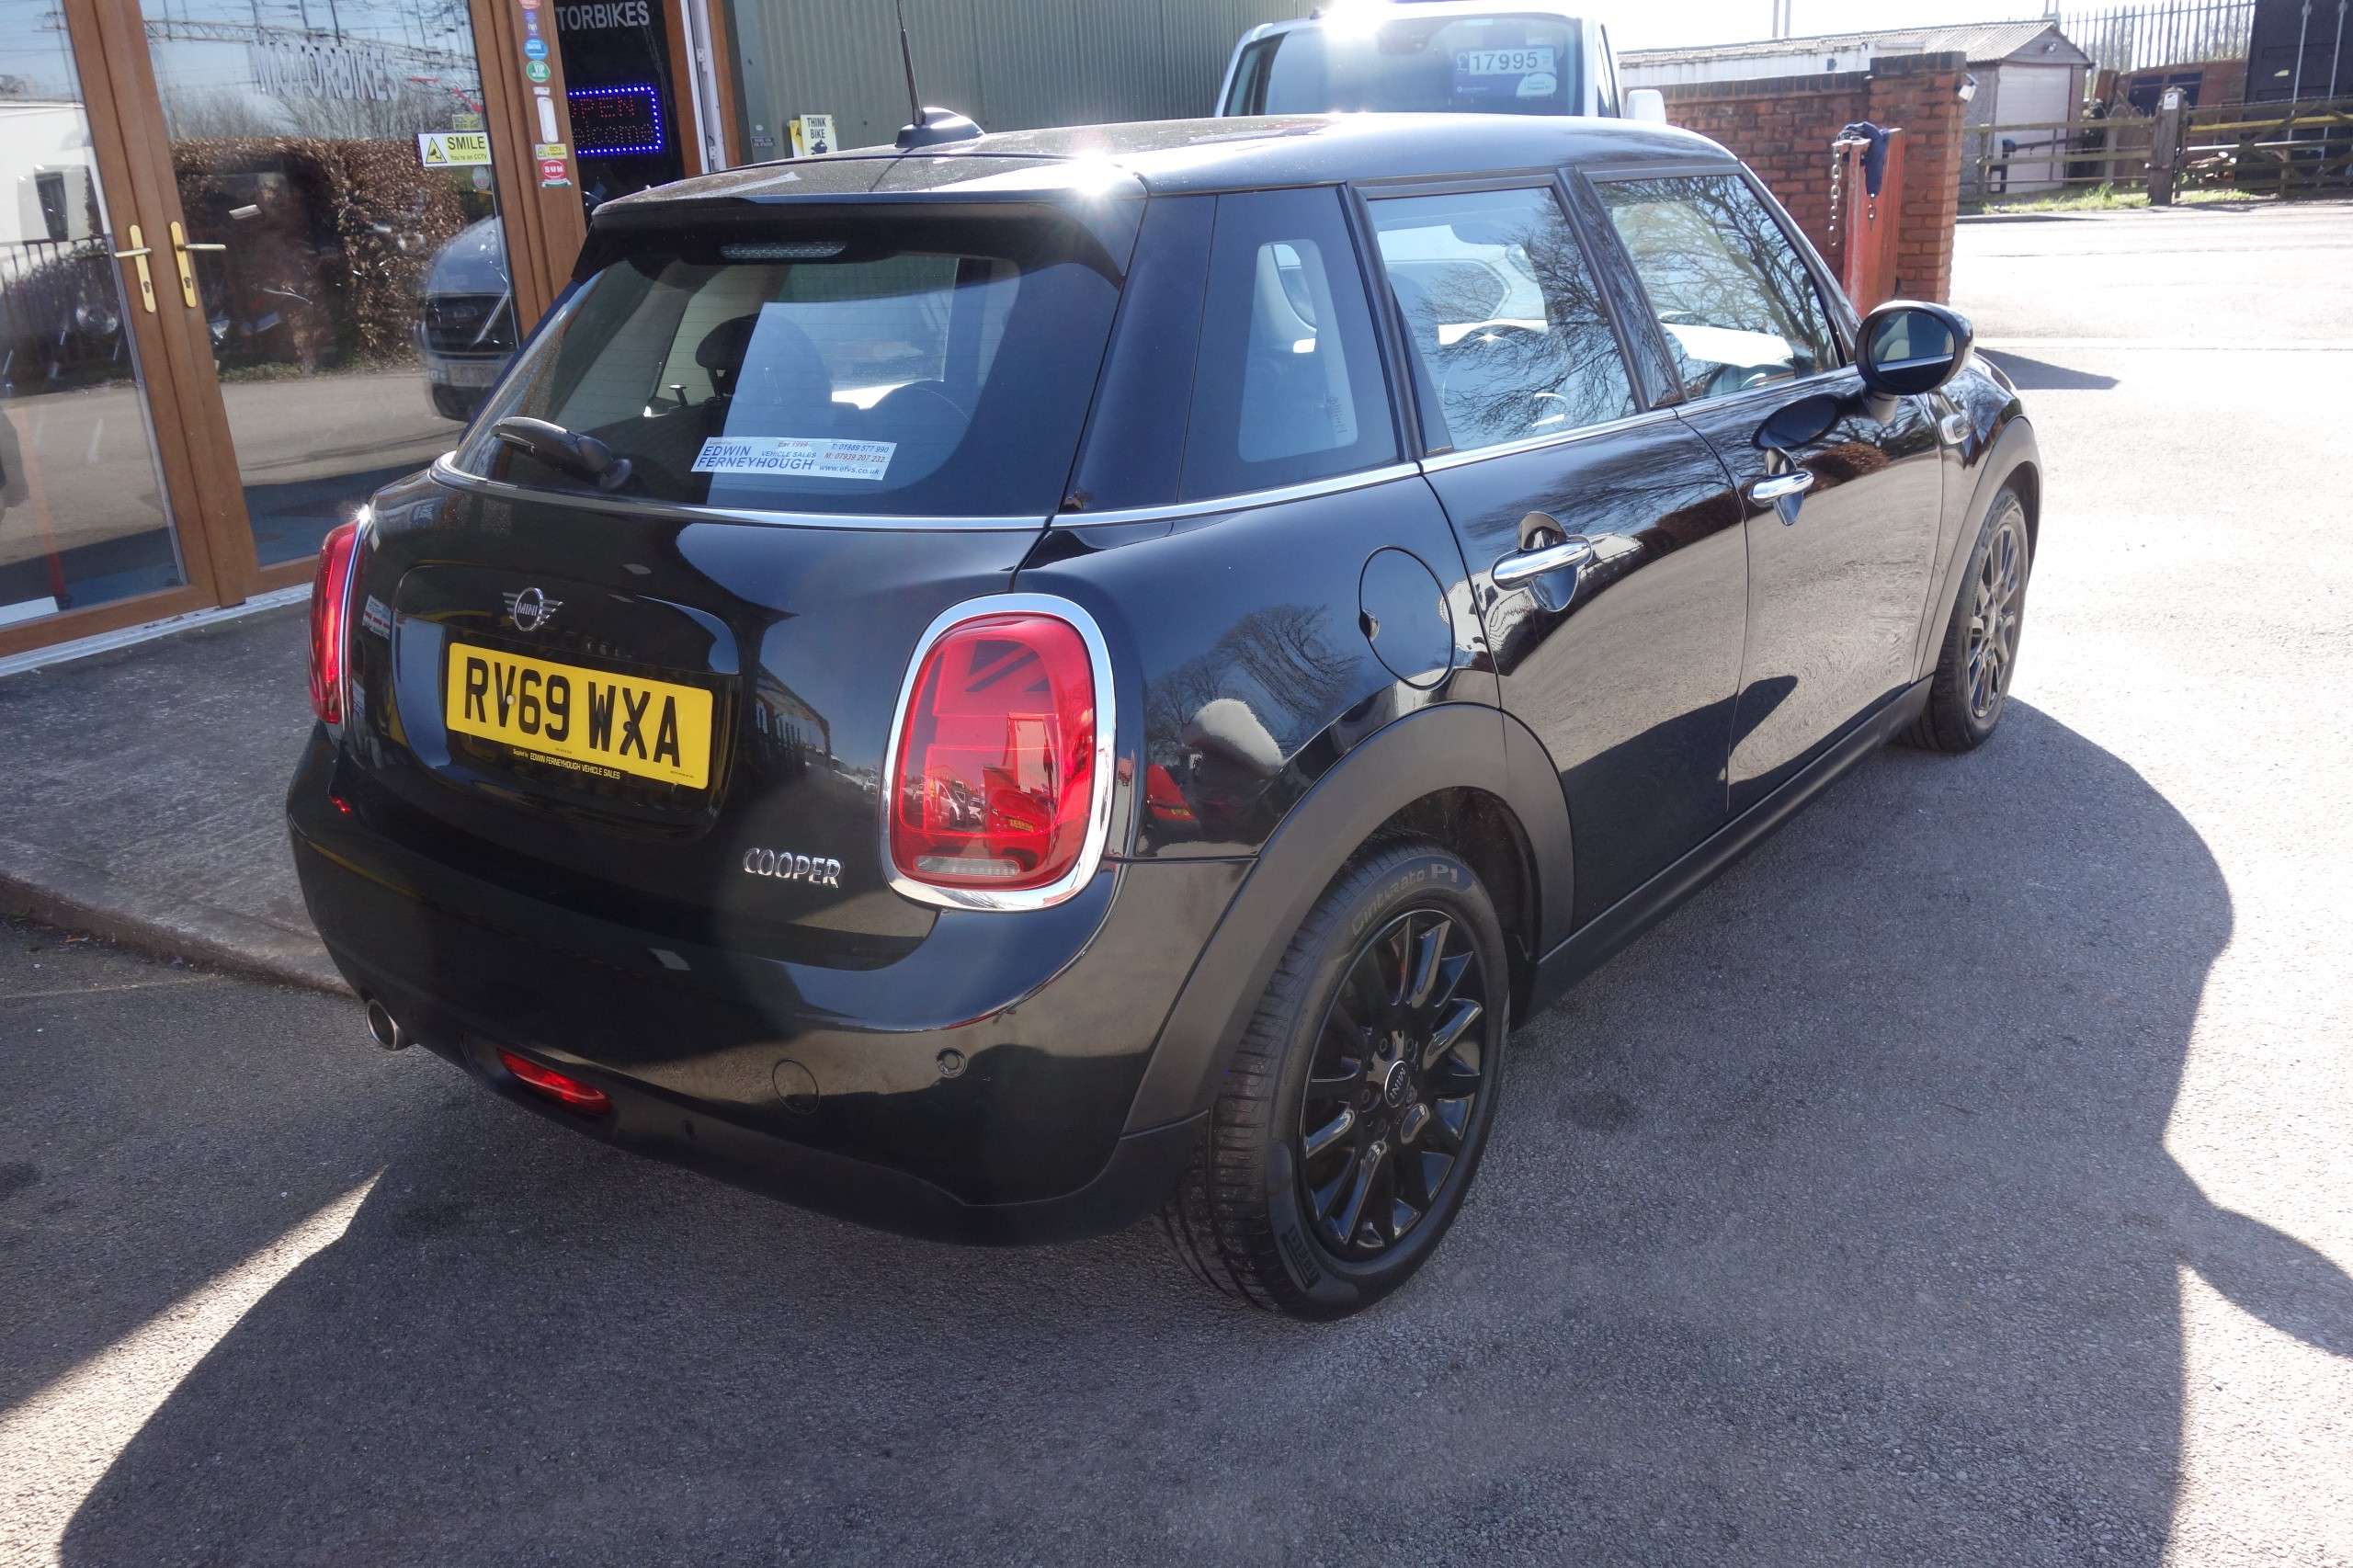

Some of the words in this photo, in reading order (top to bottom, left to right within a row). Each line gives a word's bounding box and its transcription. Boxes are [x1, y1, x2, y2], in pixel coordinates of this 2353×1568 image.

[556, 1, 650, 31] TORBIKES
[806, 117, 826, 128] THINK
[810, 129, 826, 139] BIKE
[447, 136, 486, 151] SMILE
[702, 446, 752, 457] EDWIN
[697, 457, 815, 471] FERNEYHOUGH
[517, 602, 539, 617] MINI
[464, 656, 571, 742] RV69
[588, 681, 681, 768] WXA
[529, 752, 546, 763] EDWIN
[546, 756, 581, 771] FERNEYHOUGH
[581, 764, 603, 776] VEHICLE
[603, 768, 621, 780] SALES
[743, 847, 841, 889] COOPER
